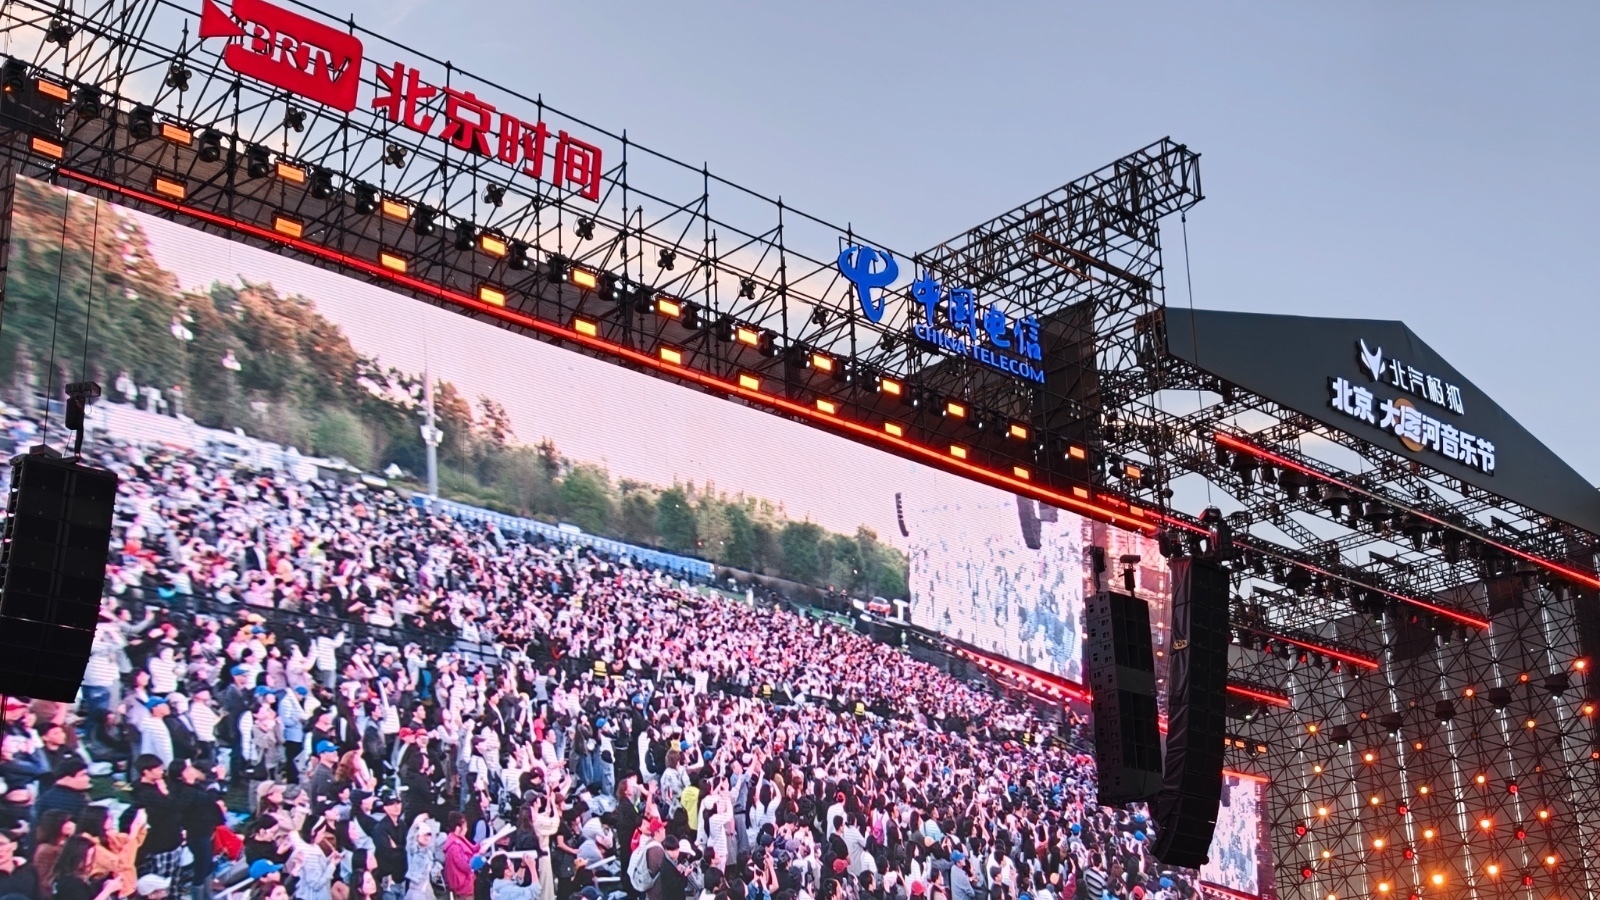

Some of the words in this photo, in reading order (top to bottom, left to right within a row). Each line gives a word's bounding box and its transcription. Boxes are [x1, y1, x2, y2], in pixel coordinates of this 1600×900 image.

[243, 19, 350, 83] BRTV
[372, 62, 602, 202] 北京时间
[912, 271, 1042, 360] 中国电信
[914, 323, 967, 355] CHINA
[972, 345, 1045, 383] TELECOM
[1389, 359, 1464, 415] 北汽极狐
